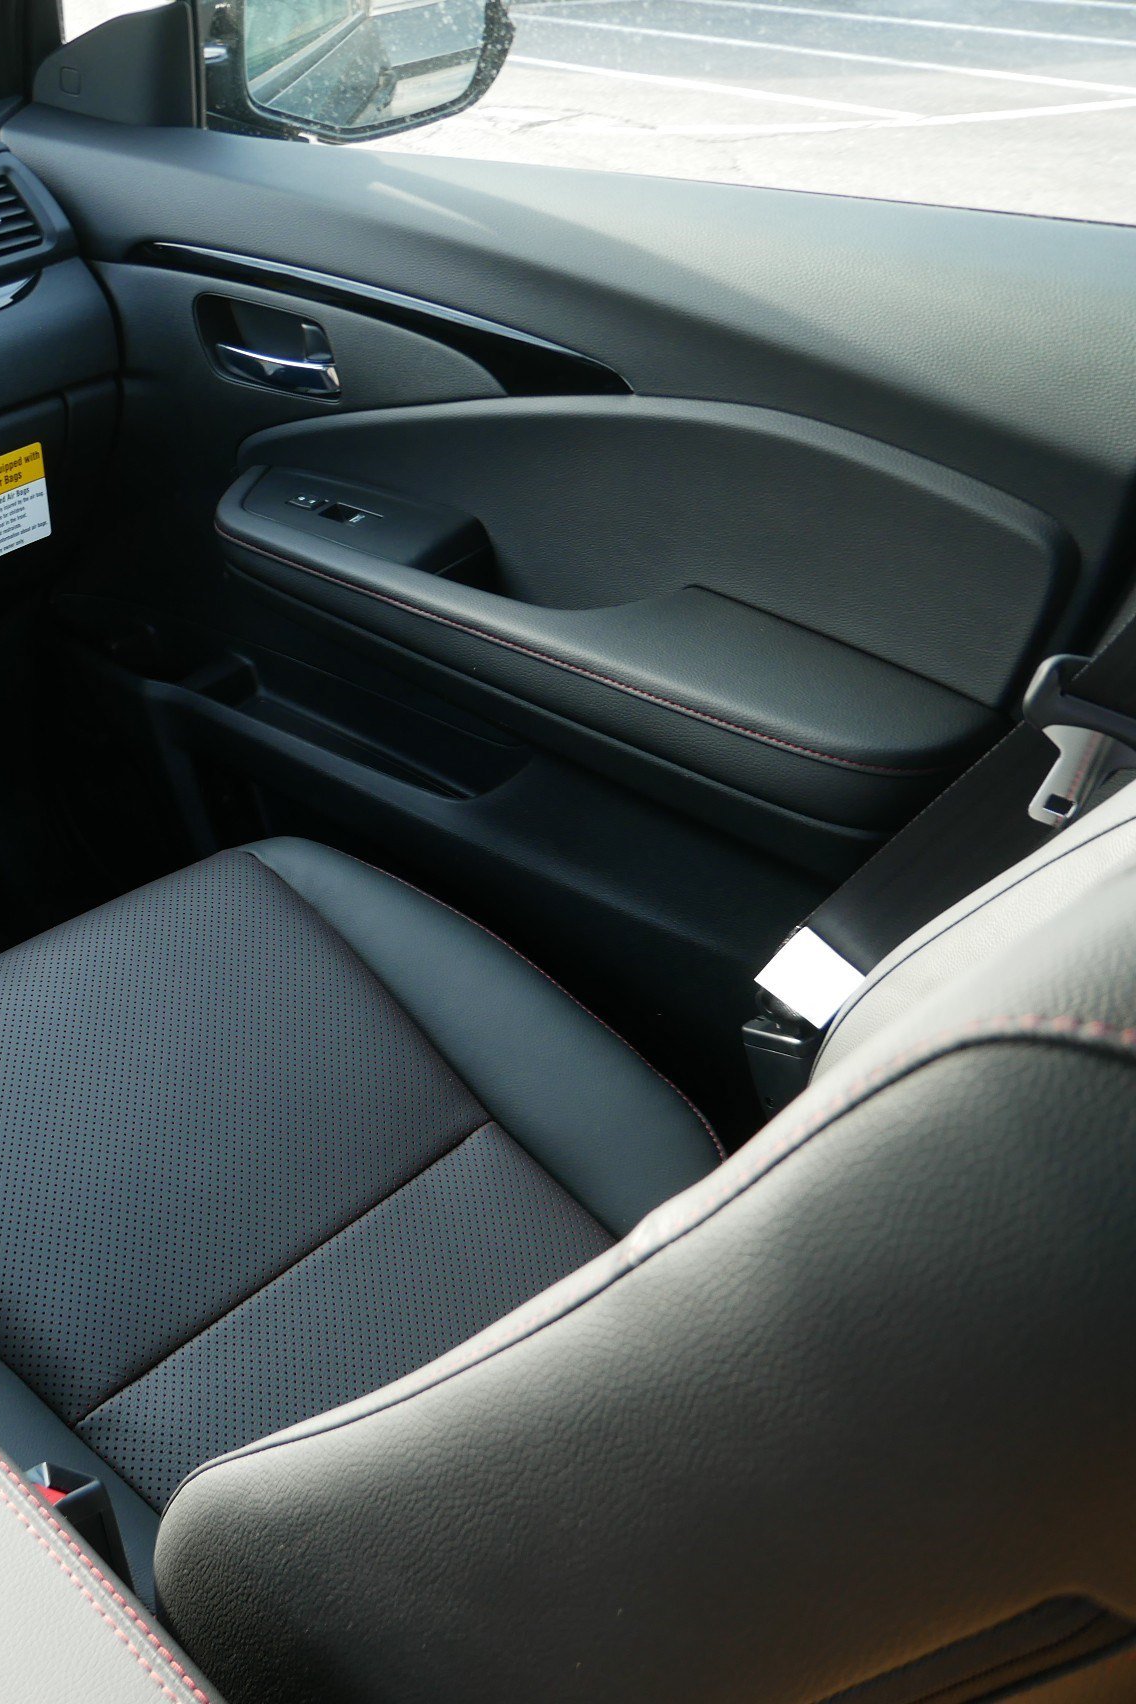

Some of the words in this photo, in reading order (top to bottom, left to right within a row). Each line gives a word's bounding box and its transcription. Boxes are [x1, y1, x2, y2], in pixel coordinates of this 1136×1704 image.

[24, 451, 41, 463] with
[4, 470, 23, 485] Bags
[7, 492, 16, 501] Air
[16, 487, 31, 498] Bags
